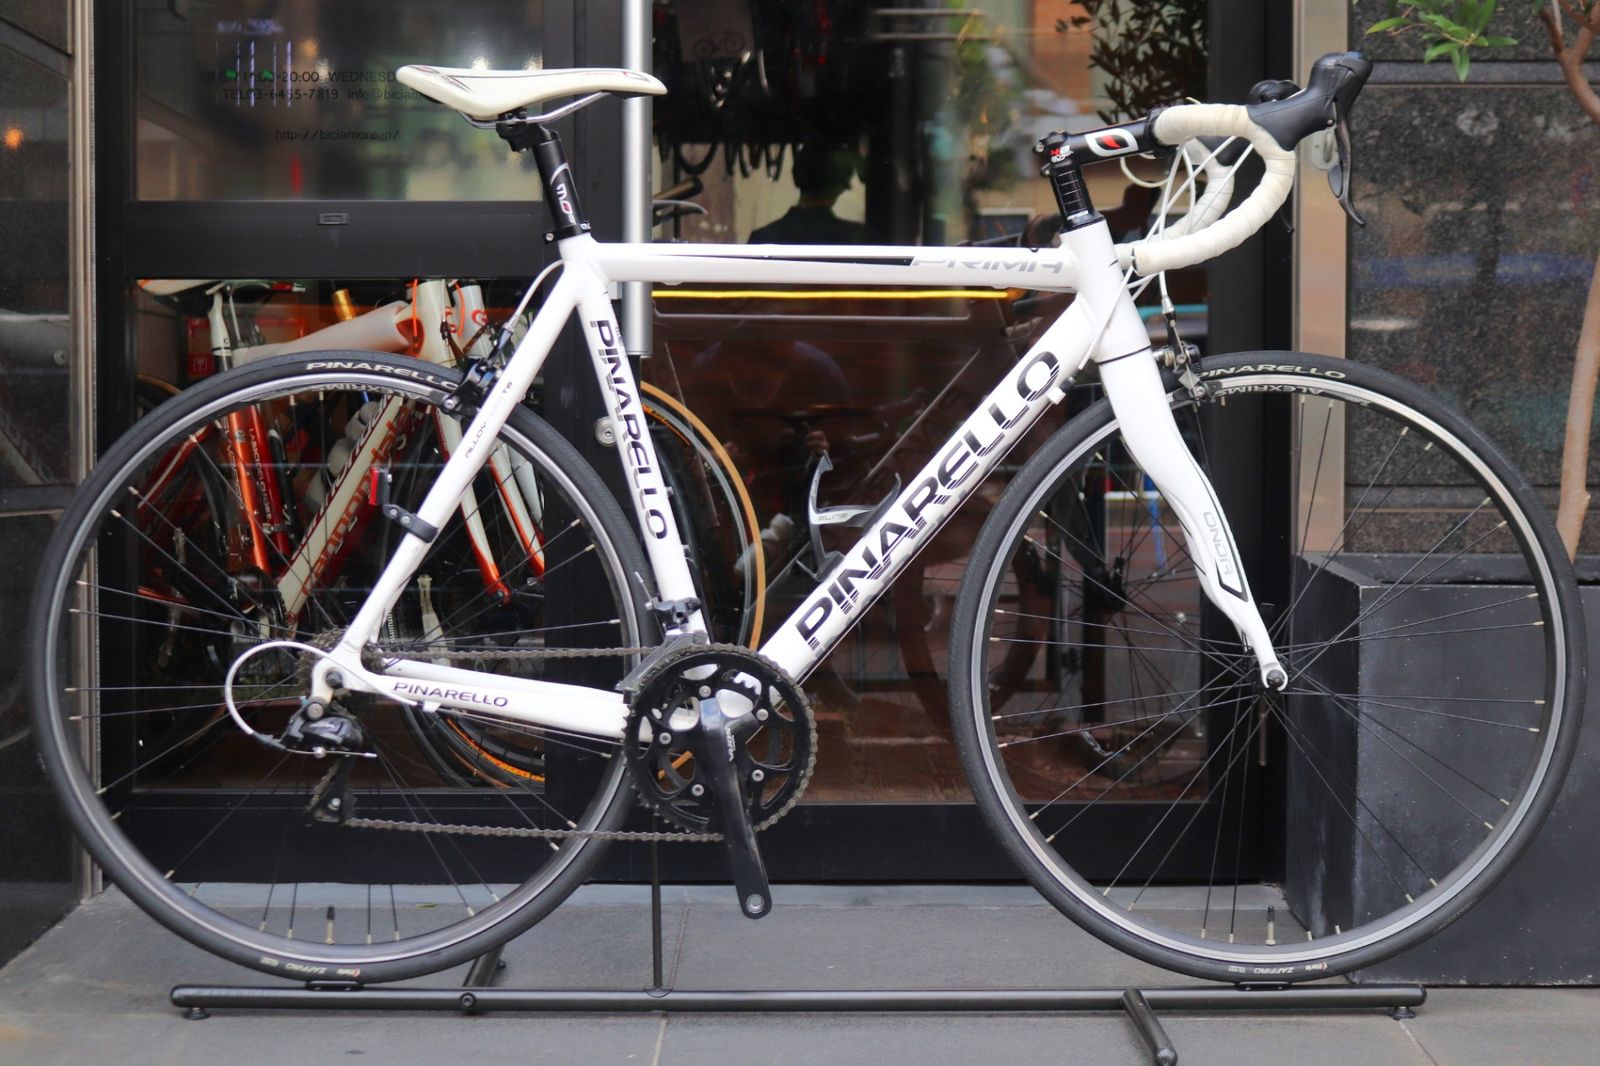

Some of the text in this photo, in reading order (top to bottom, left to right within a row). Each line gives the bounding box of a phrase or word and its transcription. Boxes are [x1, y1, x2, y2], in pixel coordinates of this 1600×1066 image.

[306, 361, 459, 390] PINARELLO
[591, 320, 668, 540] PINARELLO
[796, 351, 1060, 652] PINARELLO
[393, 682, 509, 708] PINARELLO
